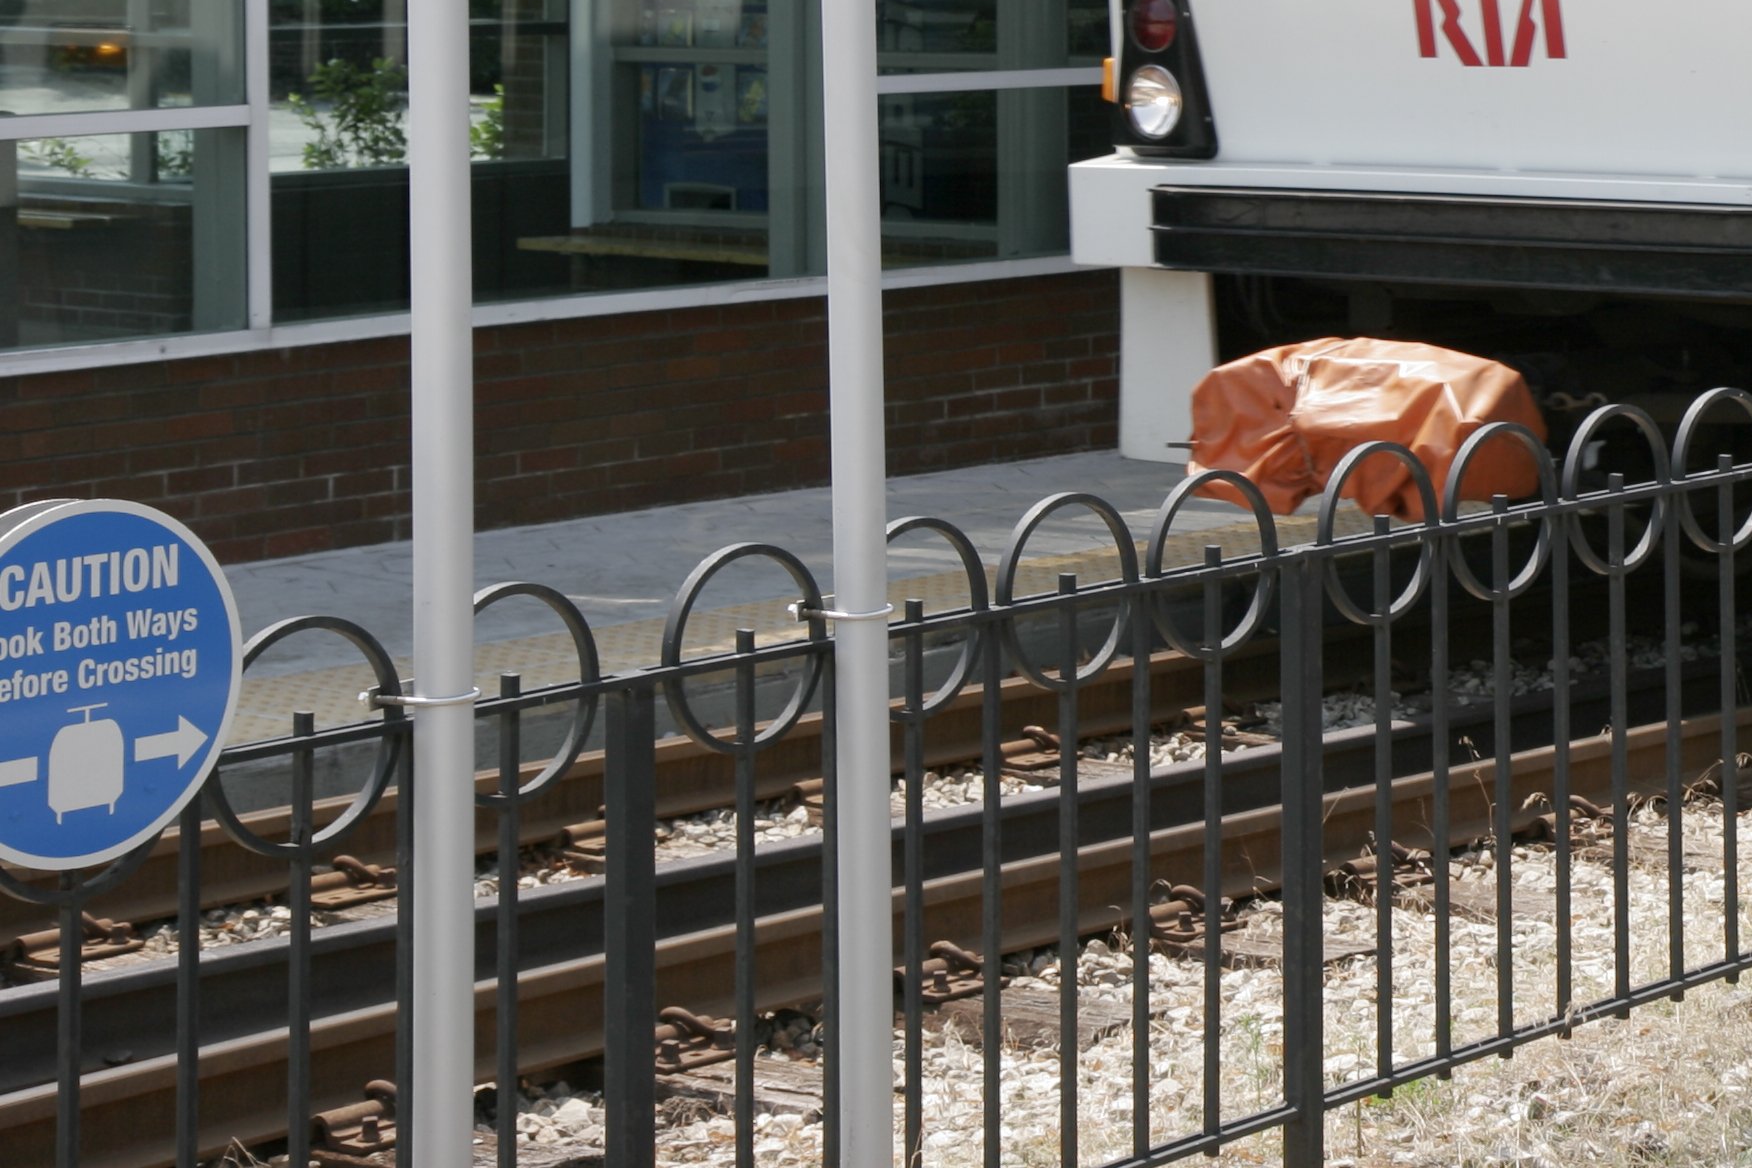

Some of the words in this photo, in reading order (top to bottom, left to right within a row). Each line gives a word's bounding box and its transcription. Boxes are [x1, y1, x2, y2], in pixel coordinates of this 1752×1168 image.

[0, 543, 179, 611] CAUTION
[0, 626, 44, 661] ook
[55, 616, 118, 651] Both
[127, 608, 198, 640] Ways
[0, 669, 69, 703] efore
[78, 648, 197, 689] Crossing
